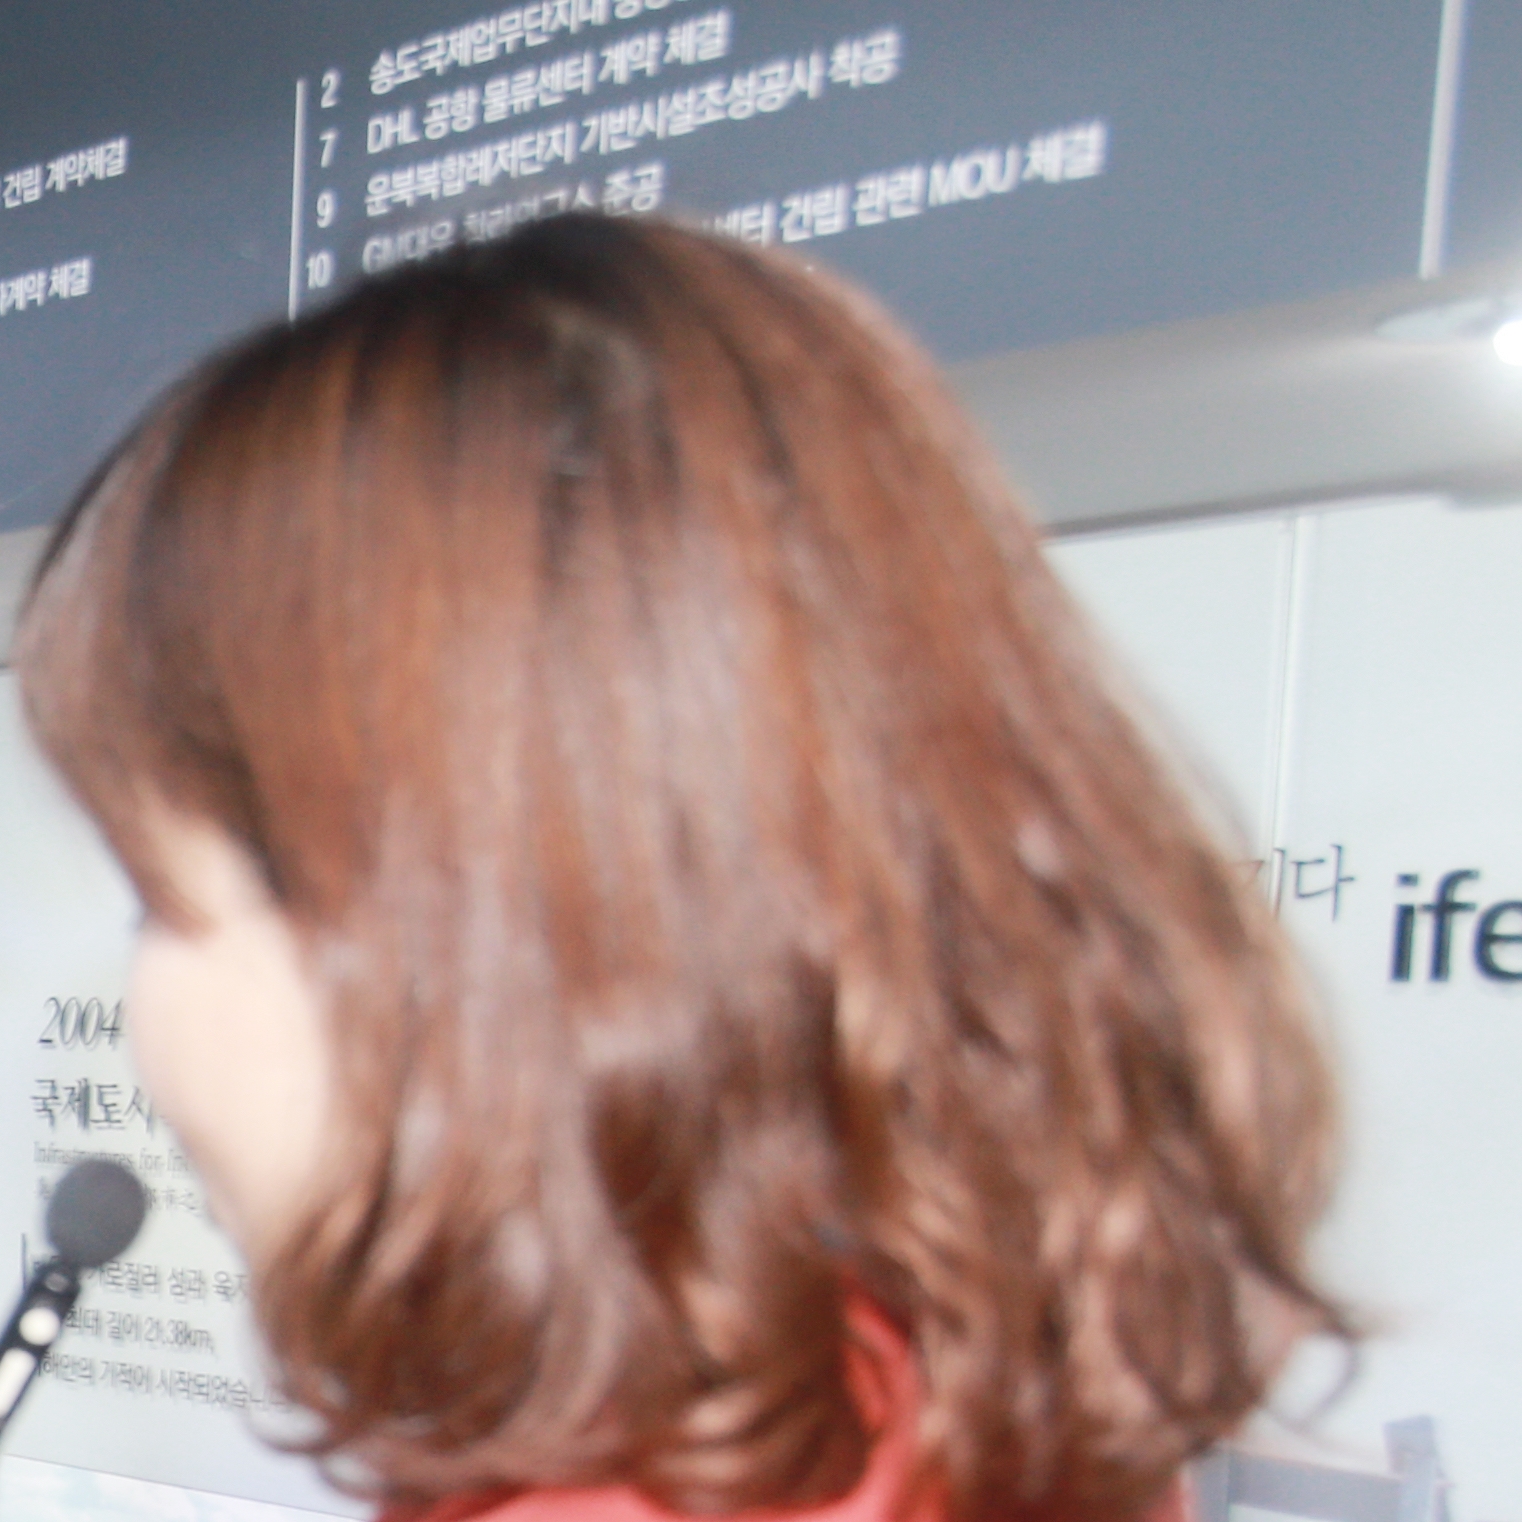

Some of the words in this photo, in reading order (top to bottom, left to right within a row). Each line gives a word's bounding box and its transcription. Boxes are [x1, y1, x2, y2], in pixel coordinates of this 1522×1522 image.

[316, 188, 335, 229] 9
[578, 49, 826, 155] 기반시설조성공사
[828, 27, 905, 88] 착공
[318, 126, 339, 168] 7
[367, 105, 422, 154] DHL
[423, 84, 481, 140] 공항
[481, 49, 598, 124] 물류센터
[597, 27, 664, 85] 계약
[663, 6, 734, 66] 체결
[321, 67, 341, 109] 2
[3, 163, 44, 208] 건립
[45, 135, 128, 192] 계약체결
[307, 249, 334, 289] 10
[780, 179, 852, 243] 건립
[853, 159, 927, 227] 관련
[928, 140, 1023, 207] MOU
[1023, 113, 1109, 184] 체결
[47, 255, 93, 300] 체결
